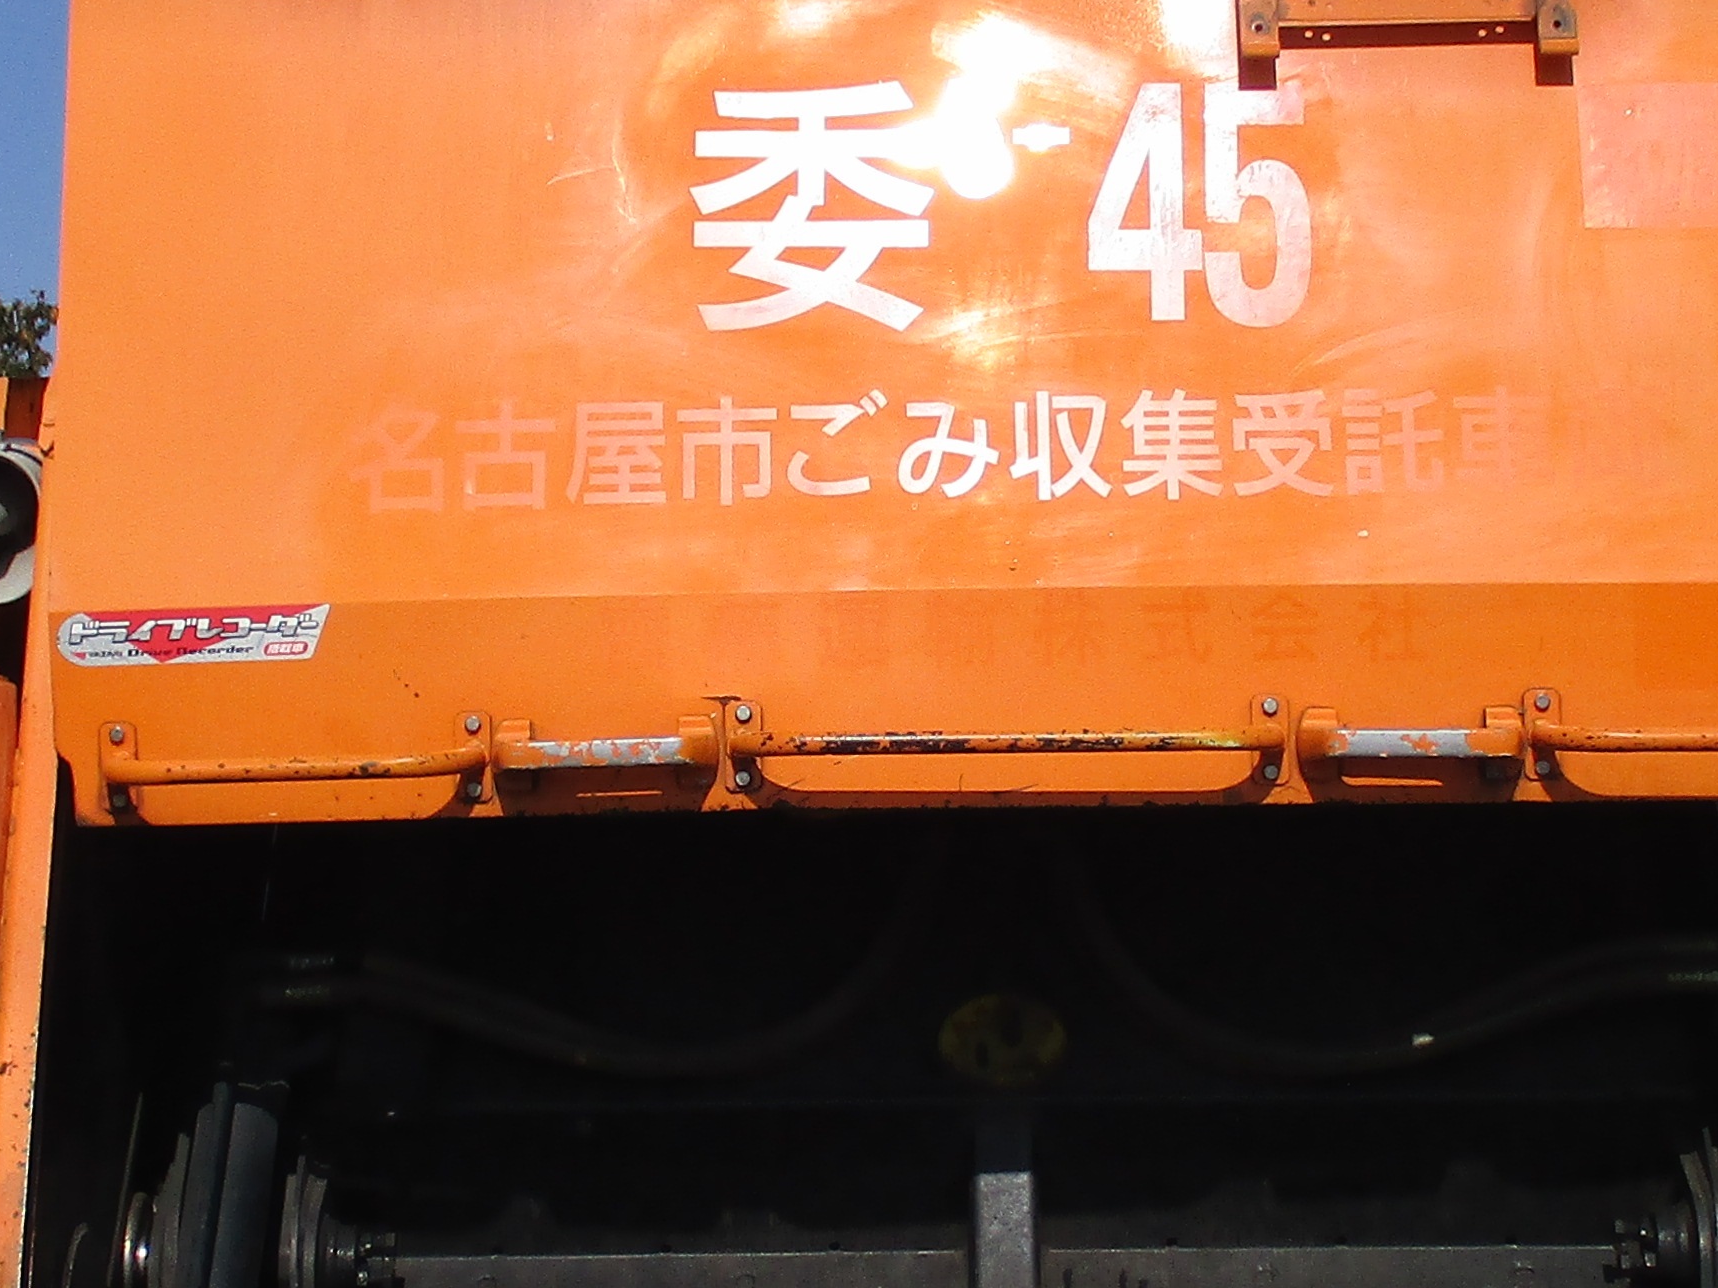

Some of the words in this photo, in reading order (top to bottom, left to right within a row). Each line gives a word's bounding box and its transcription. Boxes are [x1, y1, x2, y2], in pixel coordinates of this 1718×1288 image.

[68, 613, 320, 645] ドライブレコーダー
